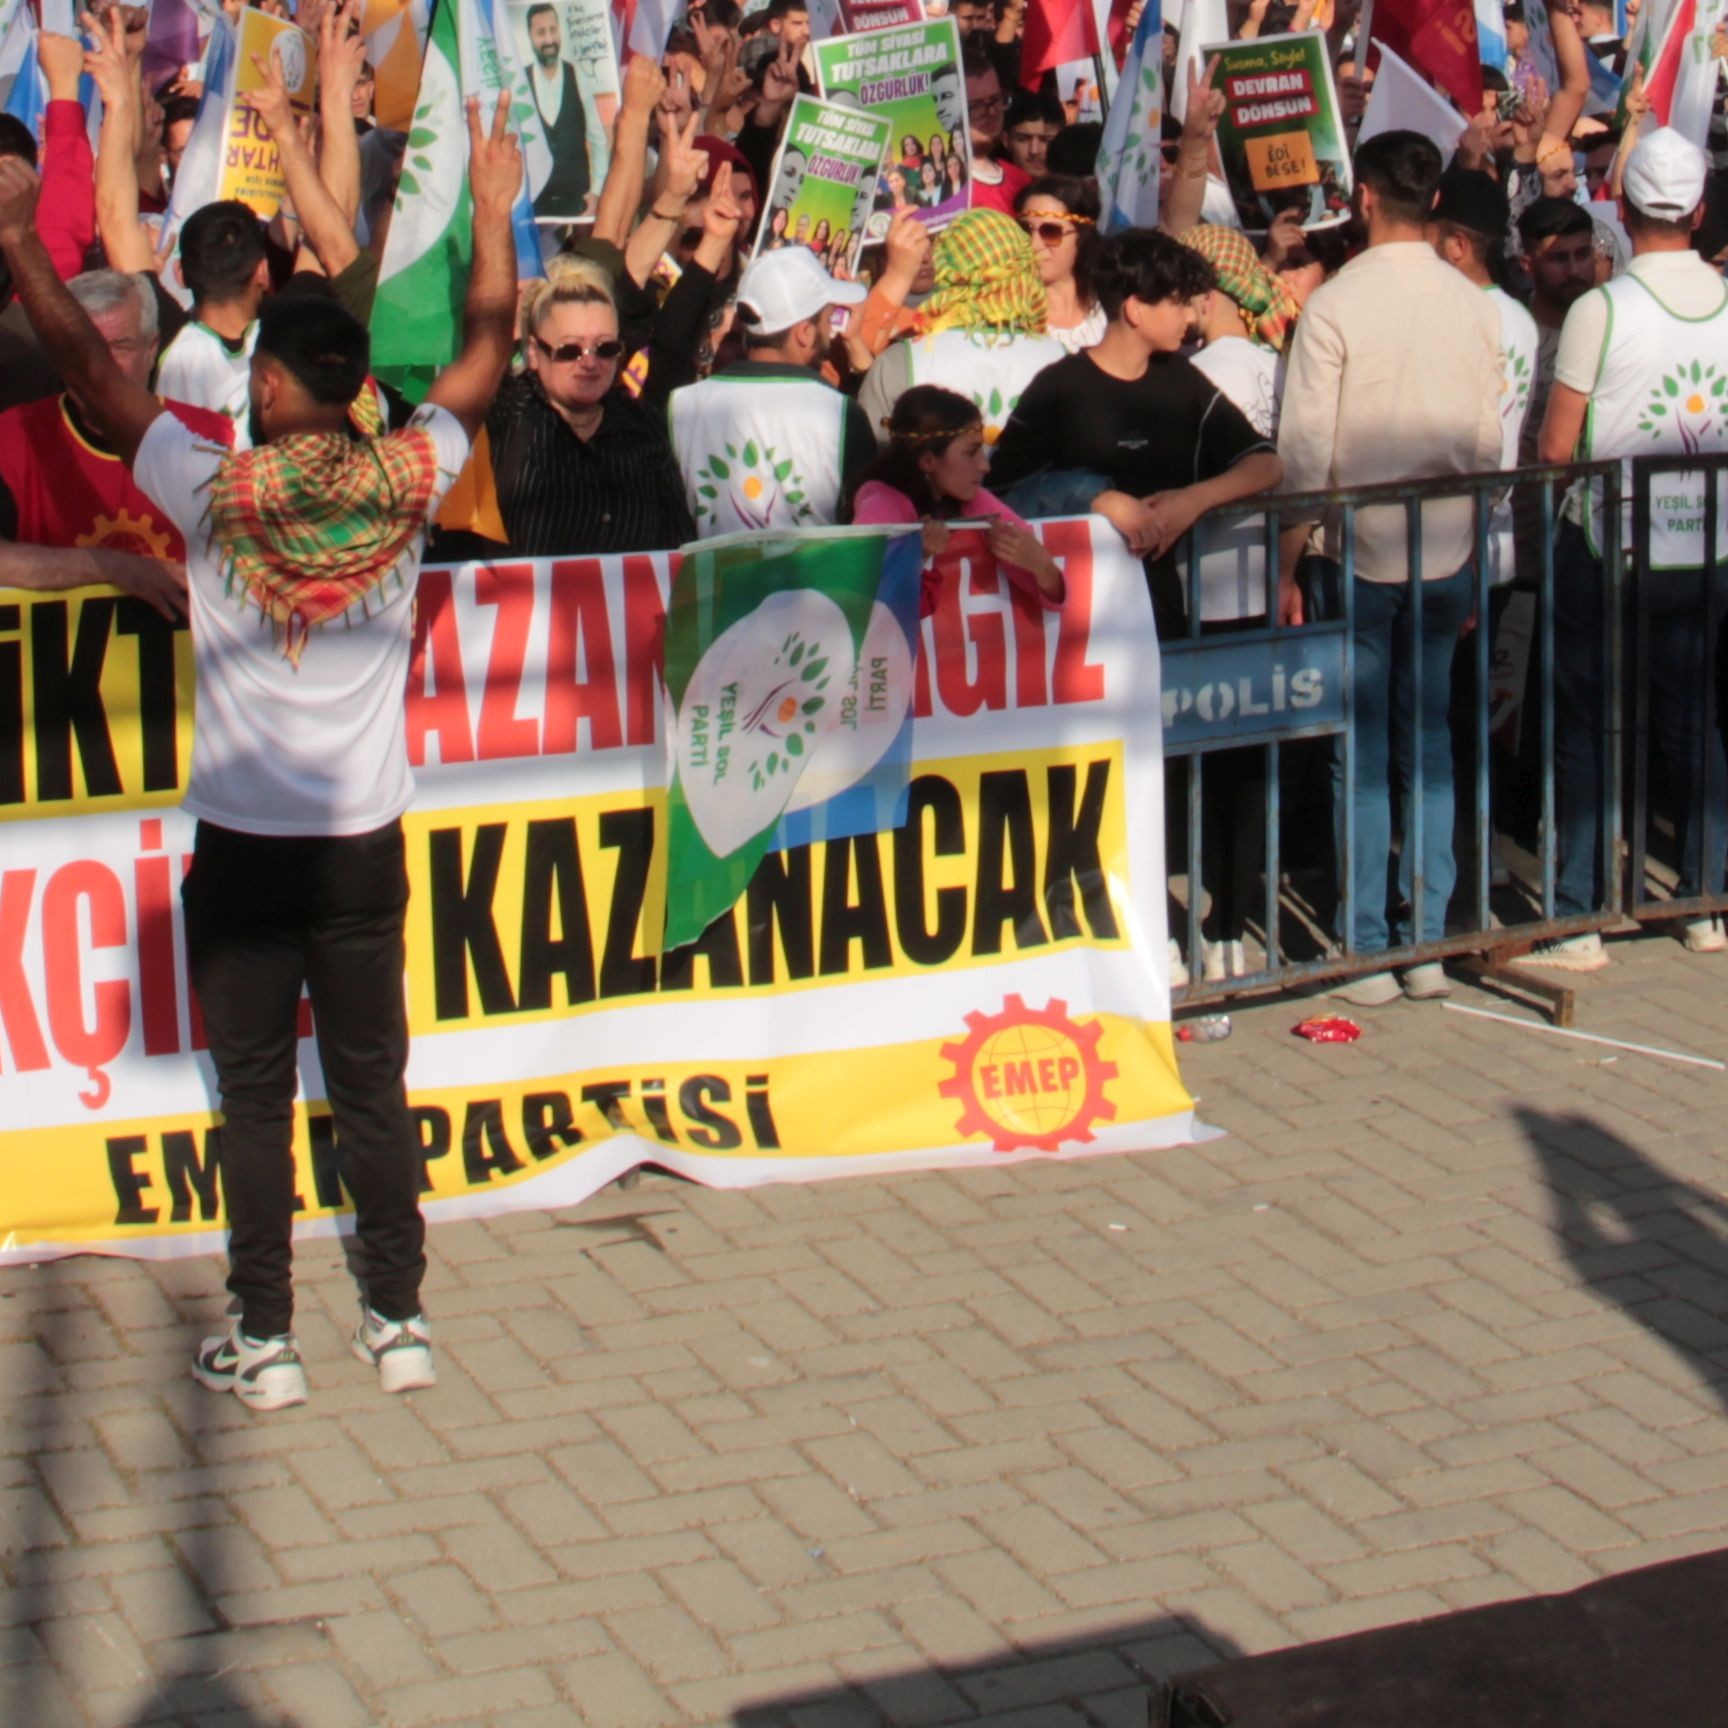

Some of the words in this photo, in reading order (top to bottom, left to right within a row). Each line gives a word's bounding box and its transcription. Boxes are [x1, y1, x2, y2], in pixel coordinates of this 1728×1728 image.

[847, 38, 877, 59] TÜM
[881, 29, 925, 53] SİYASİ
[831, 42, 949, 83] TUTSAKLARA
[860, 69, 930, 105] ÖZGÜRLÜK!
[1232, 74, 1304, 98] DEVRAN
[1237, 95, 1313, 125] DÖNSÜN
[1654, 494, 1693, 516] YEŞİL
[1666, 517, 1703, 534] PART
[719, 680, 739, 741] YEŞİL
[689, 704, 709, 768] PARTİ
[713, 746, 731, 786] SOL
[979, 1055, 1080, 1102] EMEP
